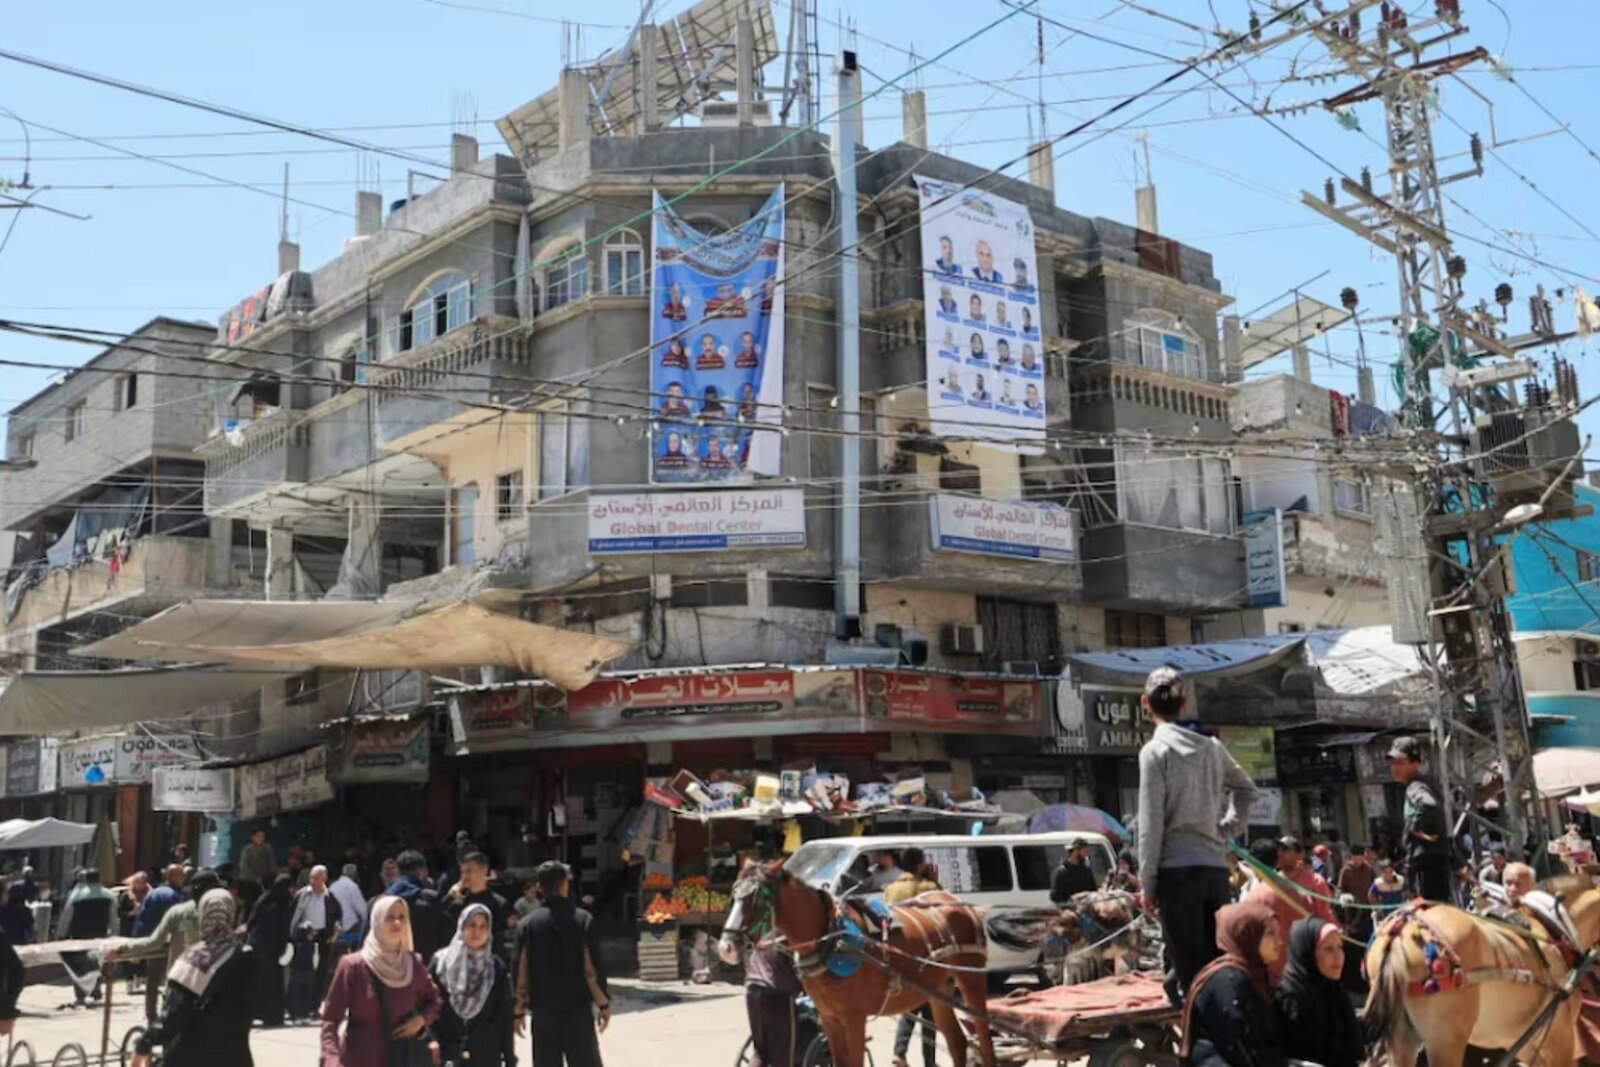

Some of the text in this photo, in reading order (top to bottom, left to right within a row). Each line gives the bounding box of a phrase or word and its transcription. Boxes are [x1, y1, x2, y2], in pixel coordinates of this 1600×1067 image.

[659, 495, 722, 517] العالمي
[730, 493, 784, 514] المركز
[610, 518, 763, 535] Global Dental Center
[974, 525, 1007, 539] Global
[1008, 529, 1037, 543] Dental
[702, 674, 790, 698] محلات
[1097, 695, 1131, 725] فون
